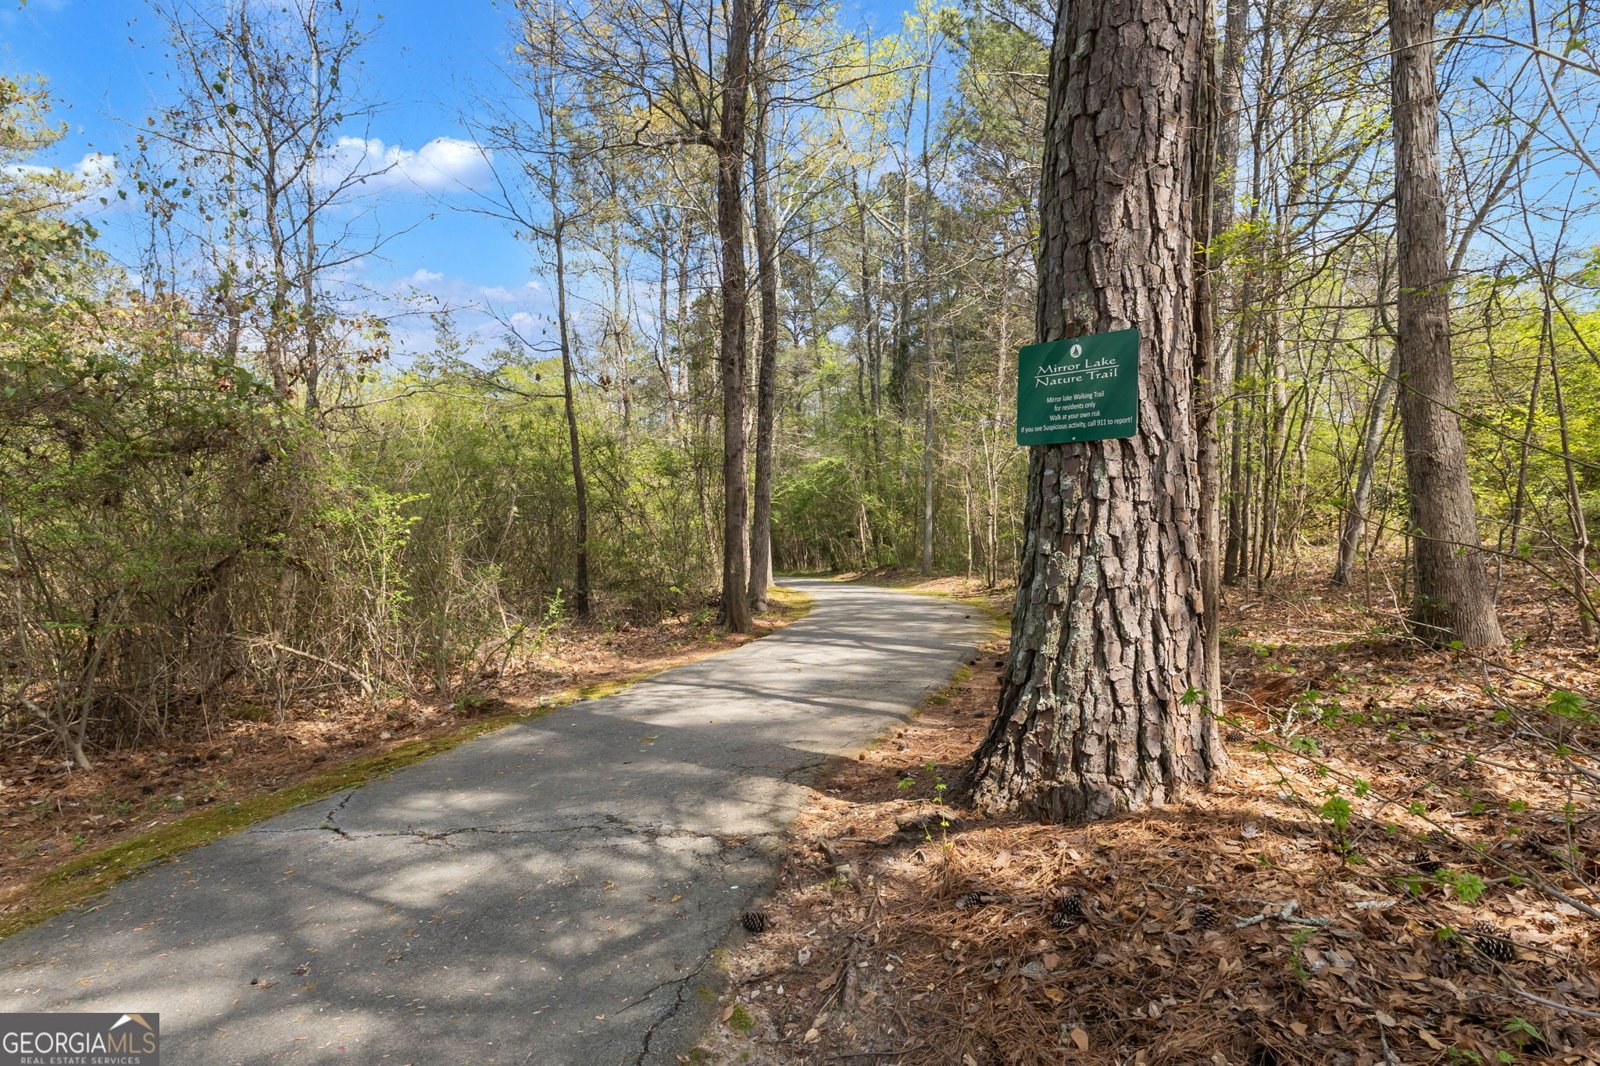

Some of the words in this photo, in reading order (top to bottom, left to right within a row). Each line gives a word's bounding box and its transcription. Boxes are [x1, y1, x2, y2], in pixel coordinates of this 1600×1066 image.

[1037, 364, 1080, 375] Mirror
[1085, 357, 1116, 368] Lake
[1035, 375, 1082, 388] Nature
[1086, 368, 1117, 380] Trail
[1043, 422, 1067, 432] Suspicious
